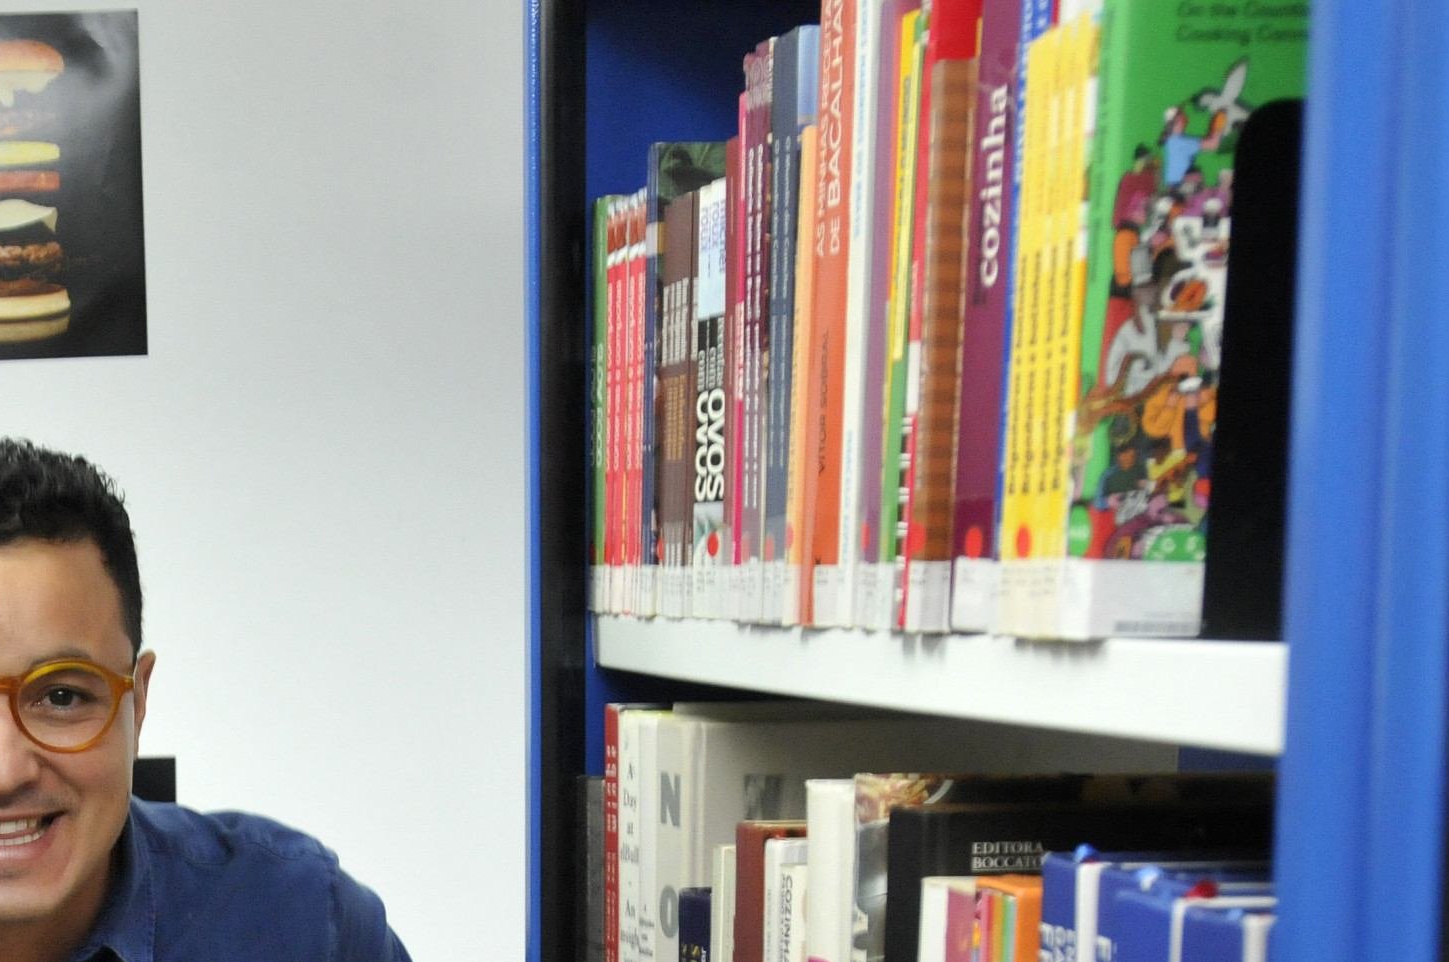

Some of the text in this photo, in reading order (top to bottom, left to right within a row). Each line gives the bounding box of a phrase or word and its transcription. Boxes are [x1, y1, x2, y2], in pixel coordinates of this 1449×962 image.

[817, 113, 829, 217] MINHAS
[979, 83, 1008, 289] cozinha
[816, 222, 826, 256] AS
[829, 216, 840, 255] DE
[818, 329, 829, 477] VITOR SOBRAL
[707, 389, 725, 501] OVOS
[972, 840, 1044, 854] EDITORA
[853, 902, 869, 936] A
